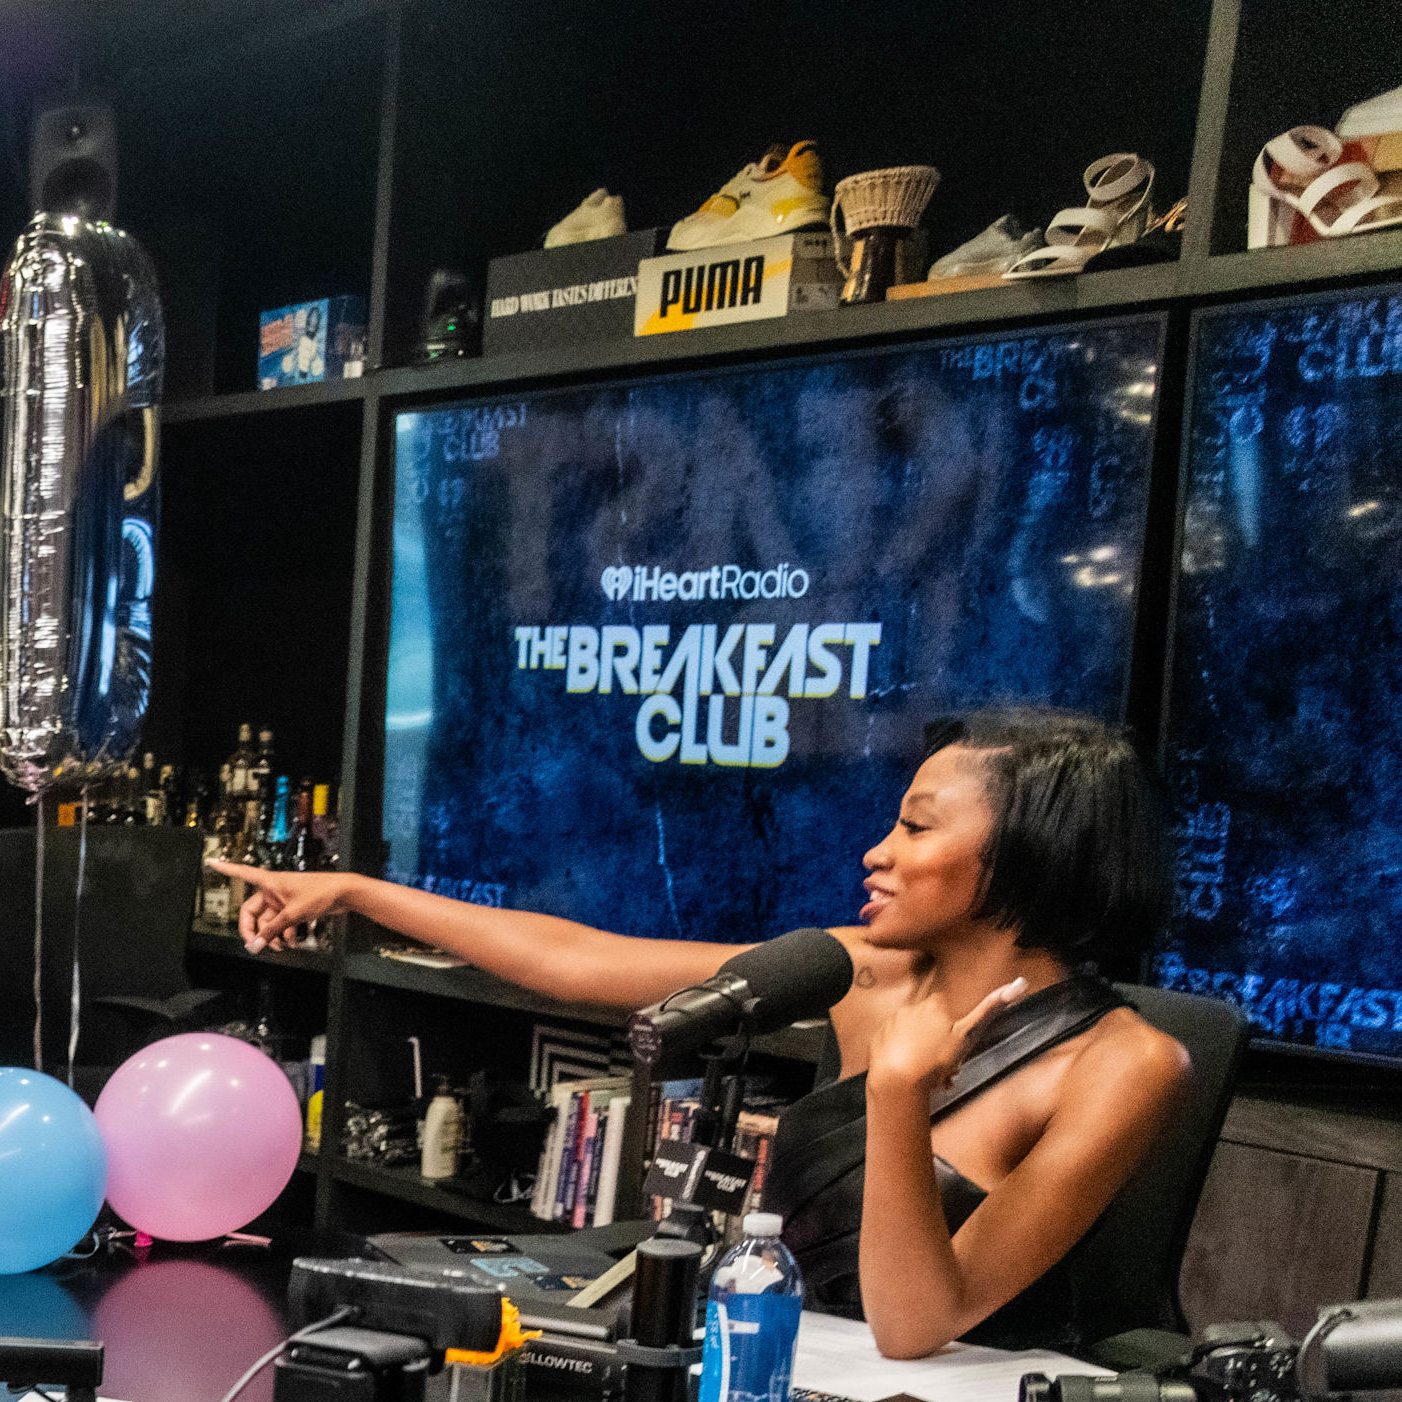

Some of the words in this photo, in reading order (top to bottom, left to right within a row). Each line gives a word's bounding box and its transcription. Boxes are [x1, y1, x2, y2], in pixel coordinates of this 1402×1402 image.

[659, 254, 766, 319] PUMA
[633, 563, 809, 601] iHeartRadio
[515, 625, 568, 669] THE
[566, 622, 882, 702] BREAKFAST
[635, 690, 790, 769] CLUB
